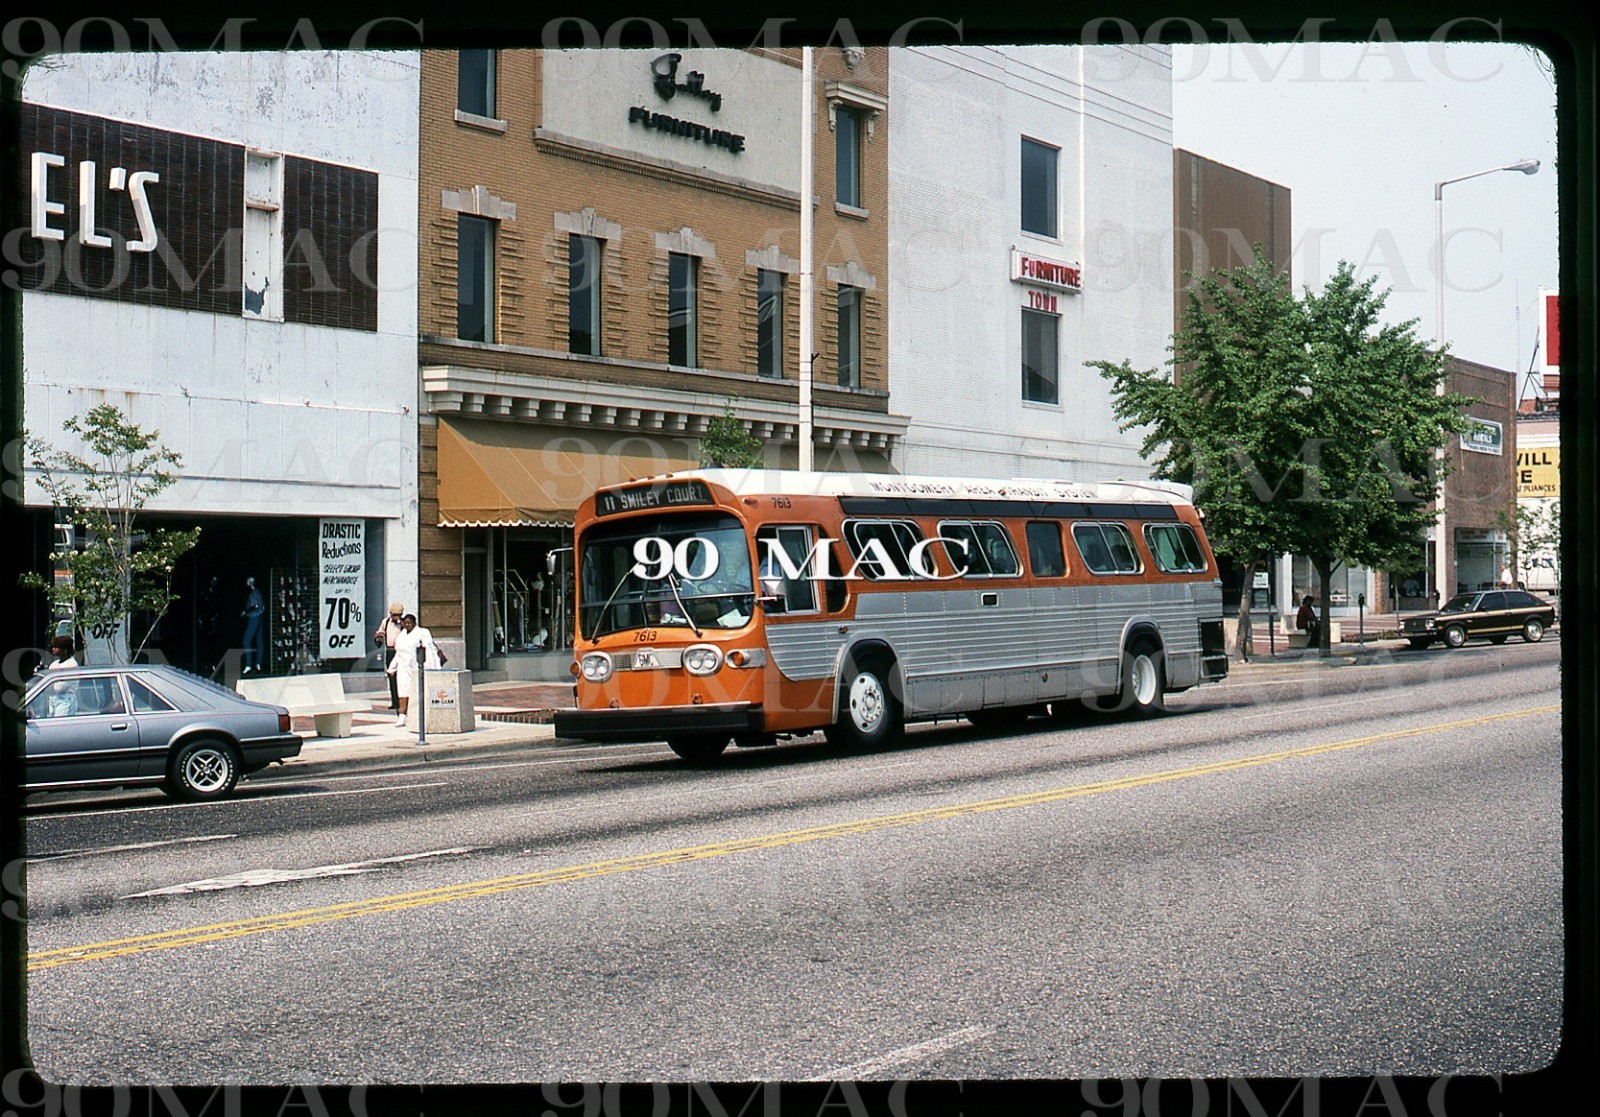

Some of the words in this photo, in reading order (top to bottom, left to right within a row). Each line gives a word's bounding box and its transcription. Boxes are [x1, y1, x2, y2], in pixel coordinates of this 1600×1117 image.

[629, 107, 745, 152] FURNITURE
[31, 152, 159, 251] EL'S
[1021, 257, 1080, 287] FURNITURE
[1028, 291, 1057, 313] TOWN
[869, 481, 955, 494] MONTGOMERY
[605, 498, 616, 511] 11
[621, 491, 661, 509] SMILEY
[667, 484, 704, 503] COURT
[771, 497, 792, 509] 7613
[322, 523, 361, 539] DRASTIC
[322, 541, 362, 559] Reductions
[323, 564, 344, 573] SELECT
[325, 597, 362, 630] 70%
[92, 623, 120, 640] OFF
[633, 631, 657, 642] 7613
[329, 634, 355, 648] OFF
